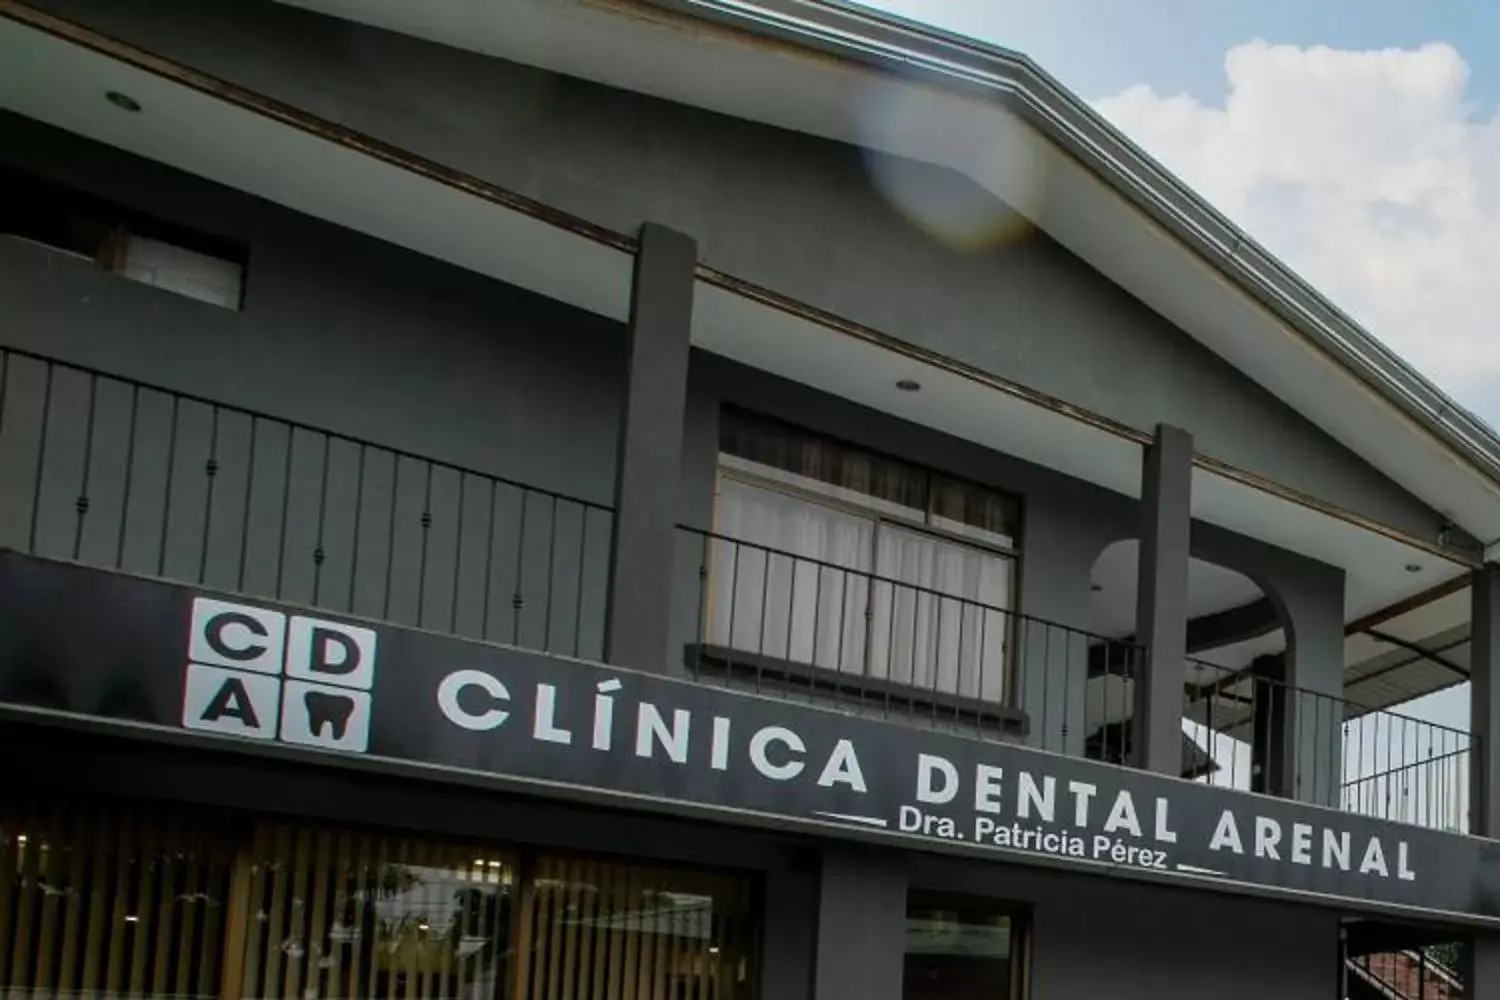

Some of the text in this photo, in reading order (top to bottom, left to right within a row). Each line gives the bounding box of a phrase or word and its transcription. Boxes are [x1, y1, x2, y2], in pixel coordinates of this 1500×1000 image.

[437, 669, 1416, 882] CLÍNICA DENTAL ARENAL
[899, 805, 1167, 869] Dra. Patricia Pérez
